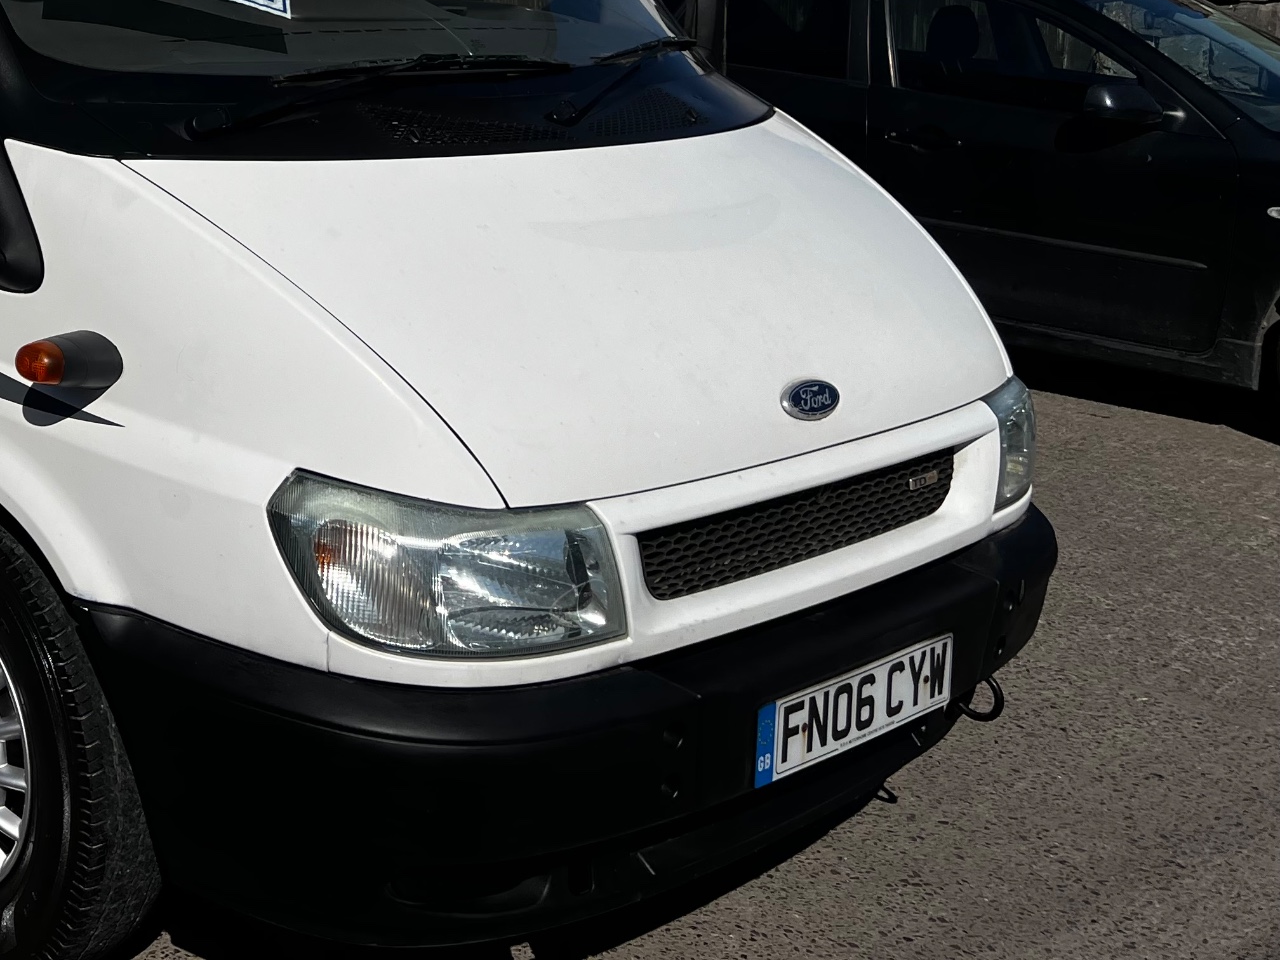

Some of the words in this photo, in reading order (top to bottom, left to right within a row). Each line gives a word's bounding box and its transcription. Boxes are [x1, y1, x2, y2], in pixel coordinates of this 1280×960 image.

[799, 385, 832, 411] Ford
[781, 673, 876, 764] FN06
[886, 642, 948, 718] CYW
[757, 753, 771, 772] GB
